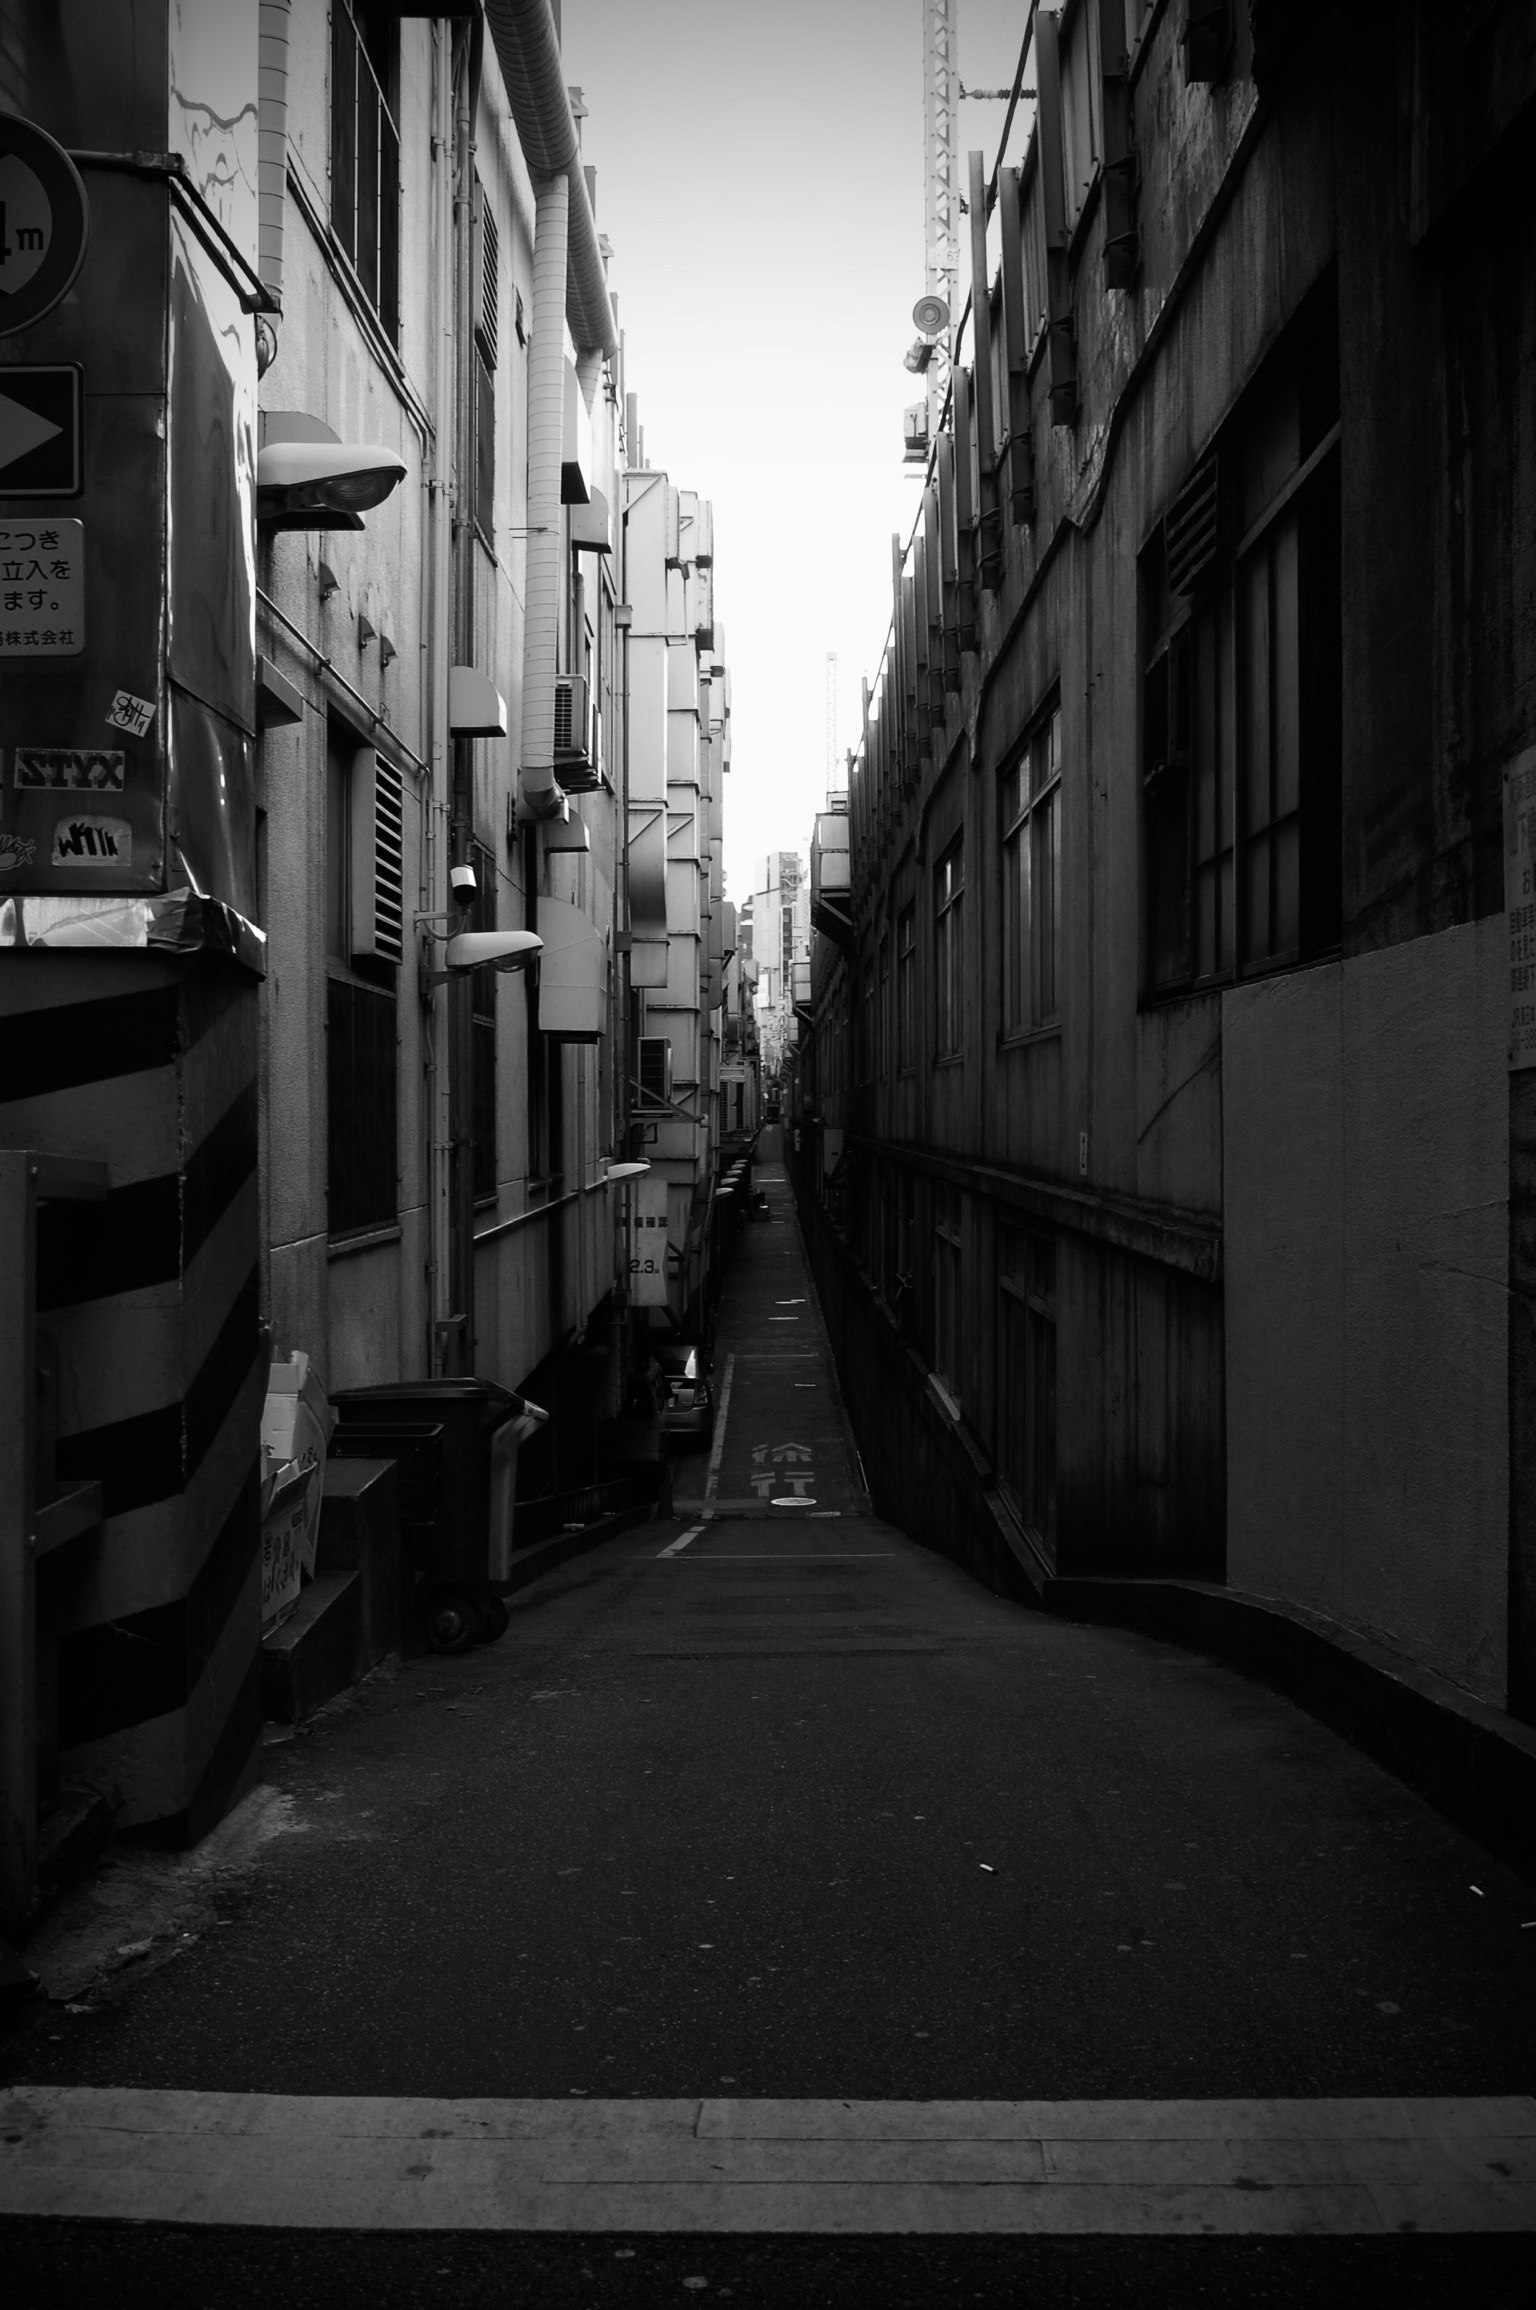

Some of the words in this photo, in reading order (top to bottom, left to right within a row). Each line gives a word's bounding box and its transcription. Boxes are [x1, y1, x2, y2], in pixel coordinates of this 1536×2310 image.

[2, 559, 71, 581] 立入を
[4, 588, 60, 611] ます。
[0, 629, 75, 646] 株式会社
[751, 1442, 815, 1498] 徐行
